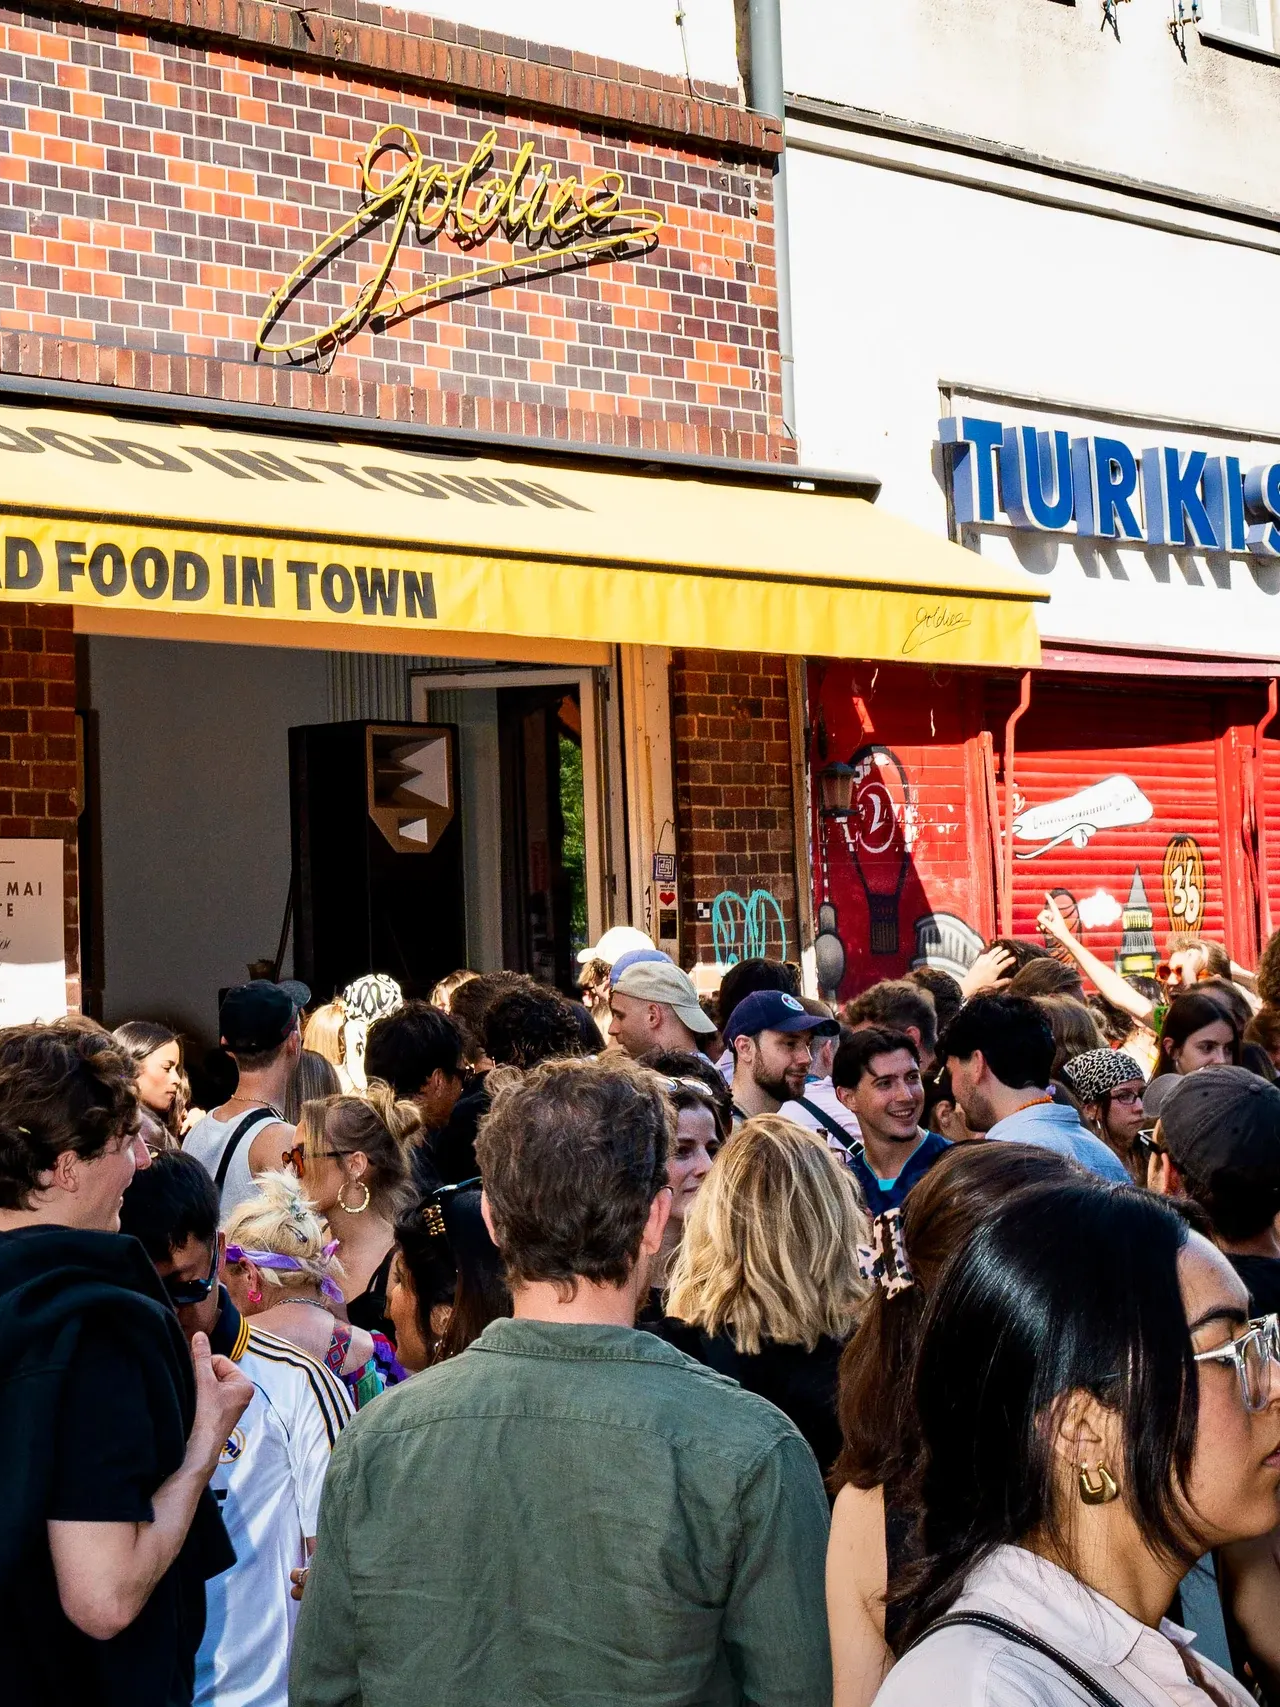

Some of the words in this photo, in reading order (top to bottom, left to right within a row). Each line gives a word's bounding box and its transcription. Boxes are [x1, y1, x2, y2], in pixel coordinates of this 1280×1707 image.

[180, 446, 322, 483] IN
[295, 456, 595, 513] TOWN
[56, 541, 211, 602] FOOD
[222, 555, 275, 607] IN
[286, 560, 437, 620] TOWN
[6, 881, 43, 896] MAI
